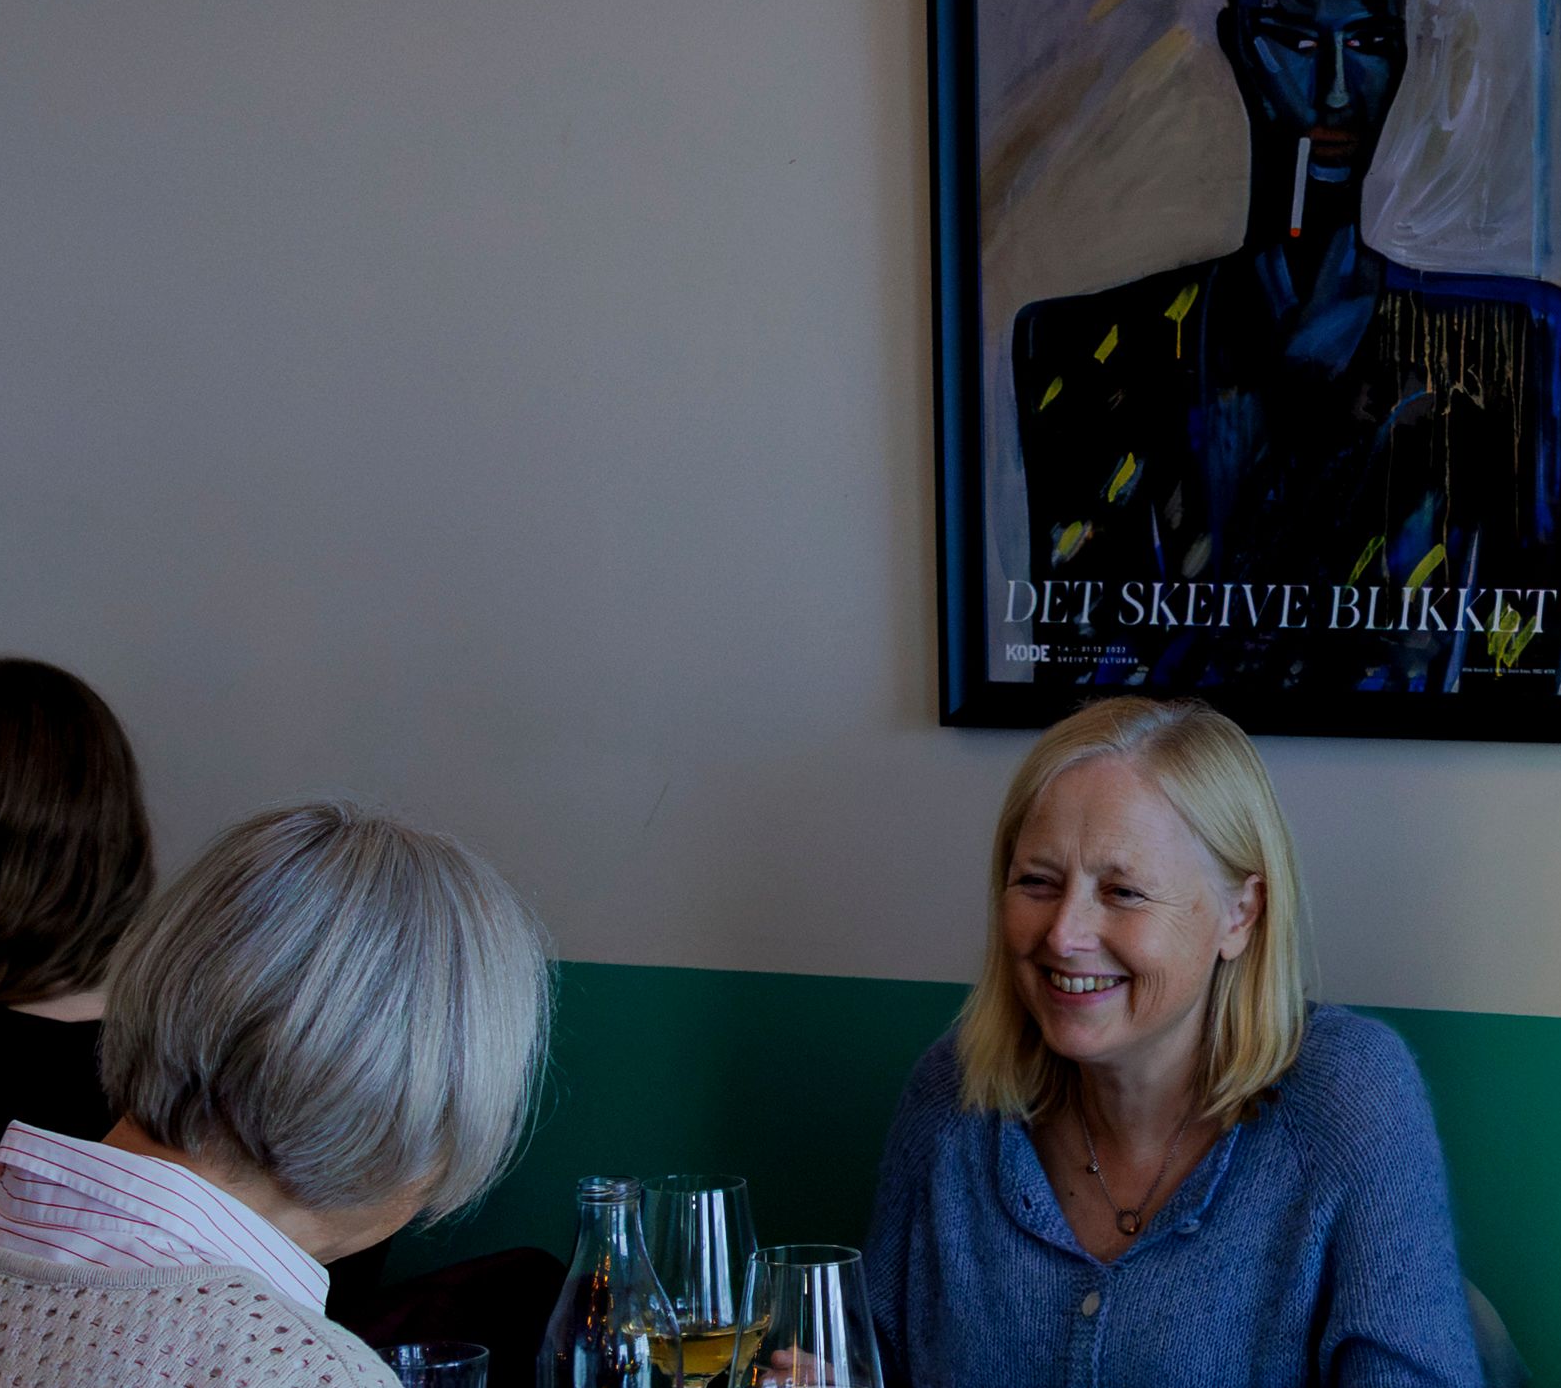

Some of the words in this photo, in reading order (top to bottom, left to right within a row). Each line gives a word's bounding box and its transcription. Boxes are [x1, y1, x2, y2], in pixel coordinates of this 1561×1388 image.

[1004, 580, 1103, 623] DET
[1118, 581, 1309, 627] SKEIVE
[1328, 585, 1557, 633] BLIKKET
[1006, 644, 1050, 662] KODE
